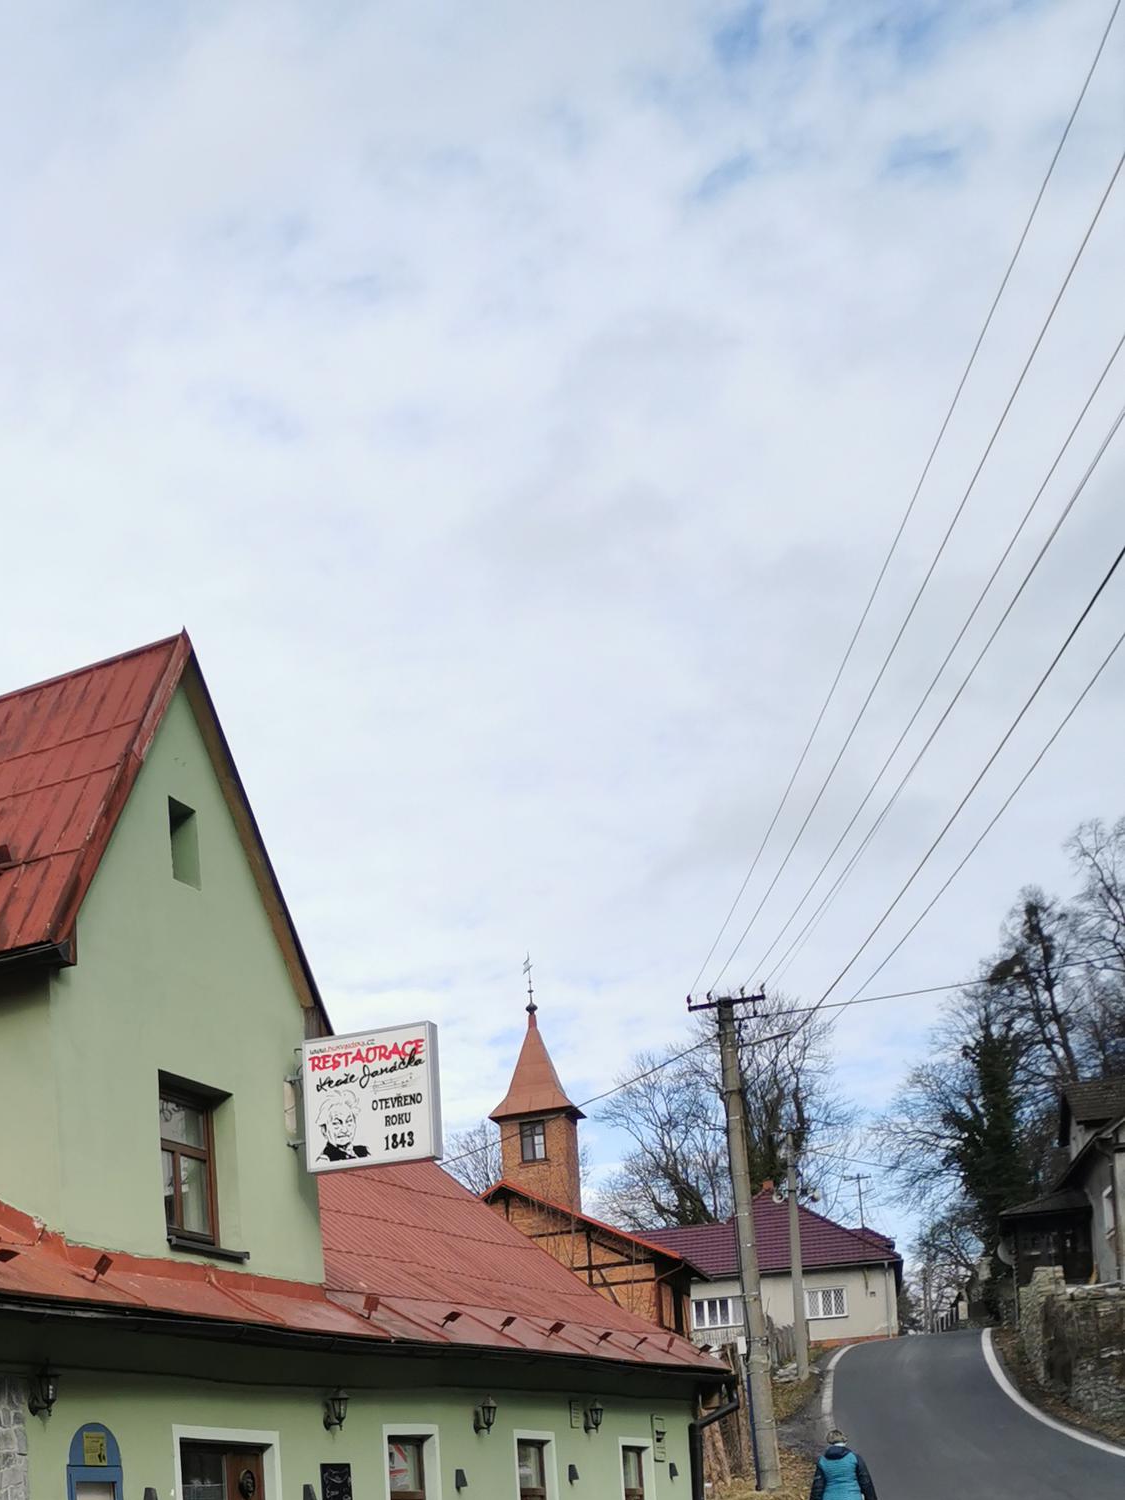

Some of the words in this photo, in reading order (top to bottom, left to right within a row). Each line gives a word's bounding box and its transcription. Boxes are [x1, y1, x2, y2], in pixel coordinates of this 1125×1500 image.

[308, 1039, 425, 1073] RESTAURACE
[359, 1047, 424, 1089] Janáčka
[371, 1092, 423, 1111] OTEVŘENO
[384, 1111, 411, 1127] ROKU
[384, 1131, 415, 1151] 1843
